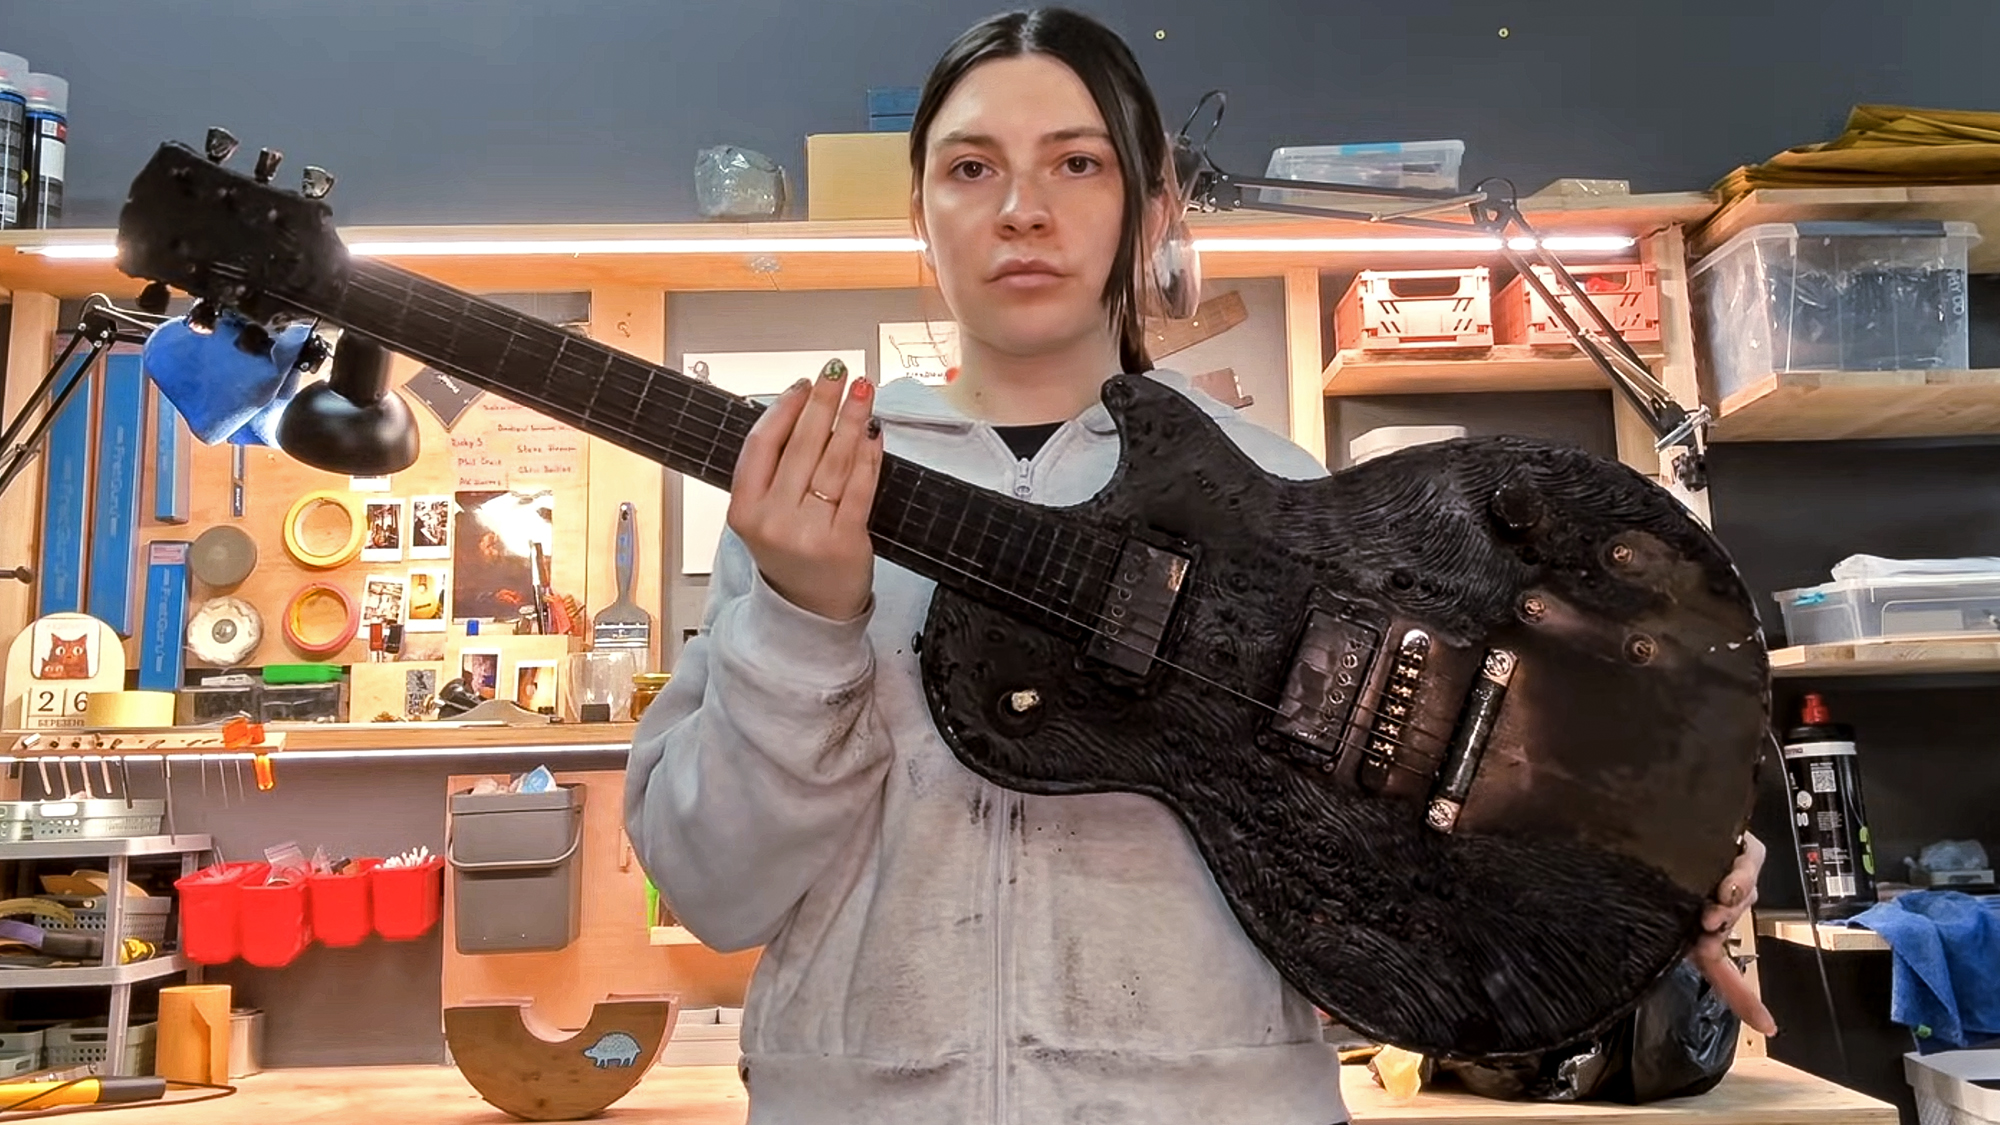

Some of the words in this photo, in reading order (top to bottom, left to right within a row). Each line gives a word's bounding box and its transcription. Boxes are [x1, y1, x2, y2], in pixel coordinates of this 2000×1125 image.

[38, 690, 54, 712] 2
[73, 690, 88, 713] 6
[38, 719, 85, 728] БЕРЕЗЕН
